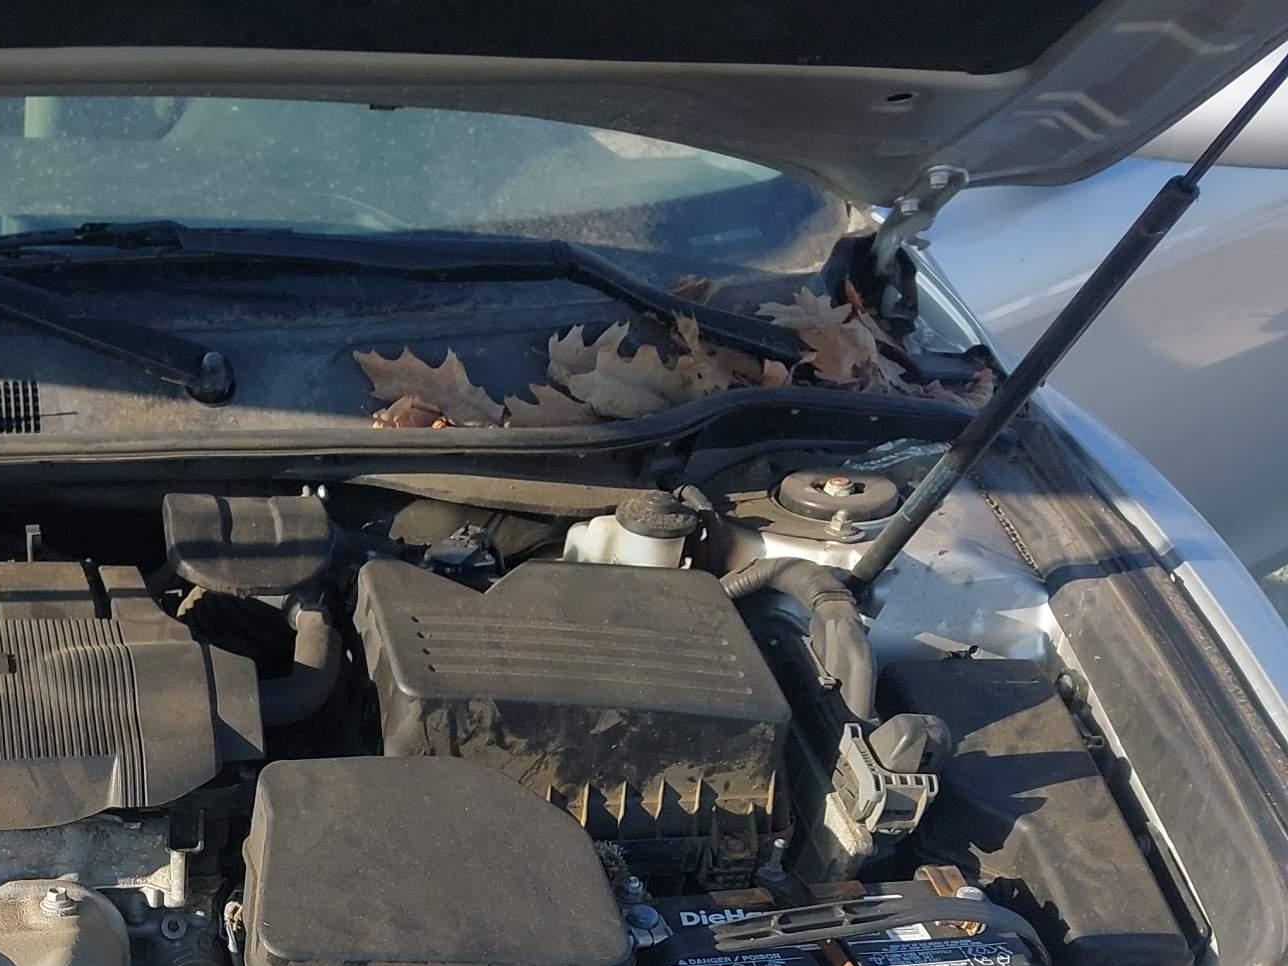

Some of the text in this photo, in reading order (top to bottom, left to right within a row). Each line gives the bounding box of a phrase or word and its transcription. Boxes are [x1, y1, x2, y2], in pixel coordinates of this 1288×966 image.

[680, 908, 768, 927] DieH
[687, 956, 732, 965] DANGER
[742, 952, 782, 962] POISON
